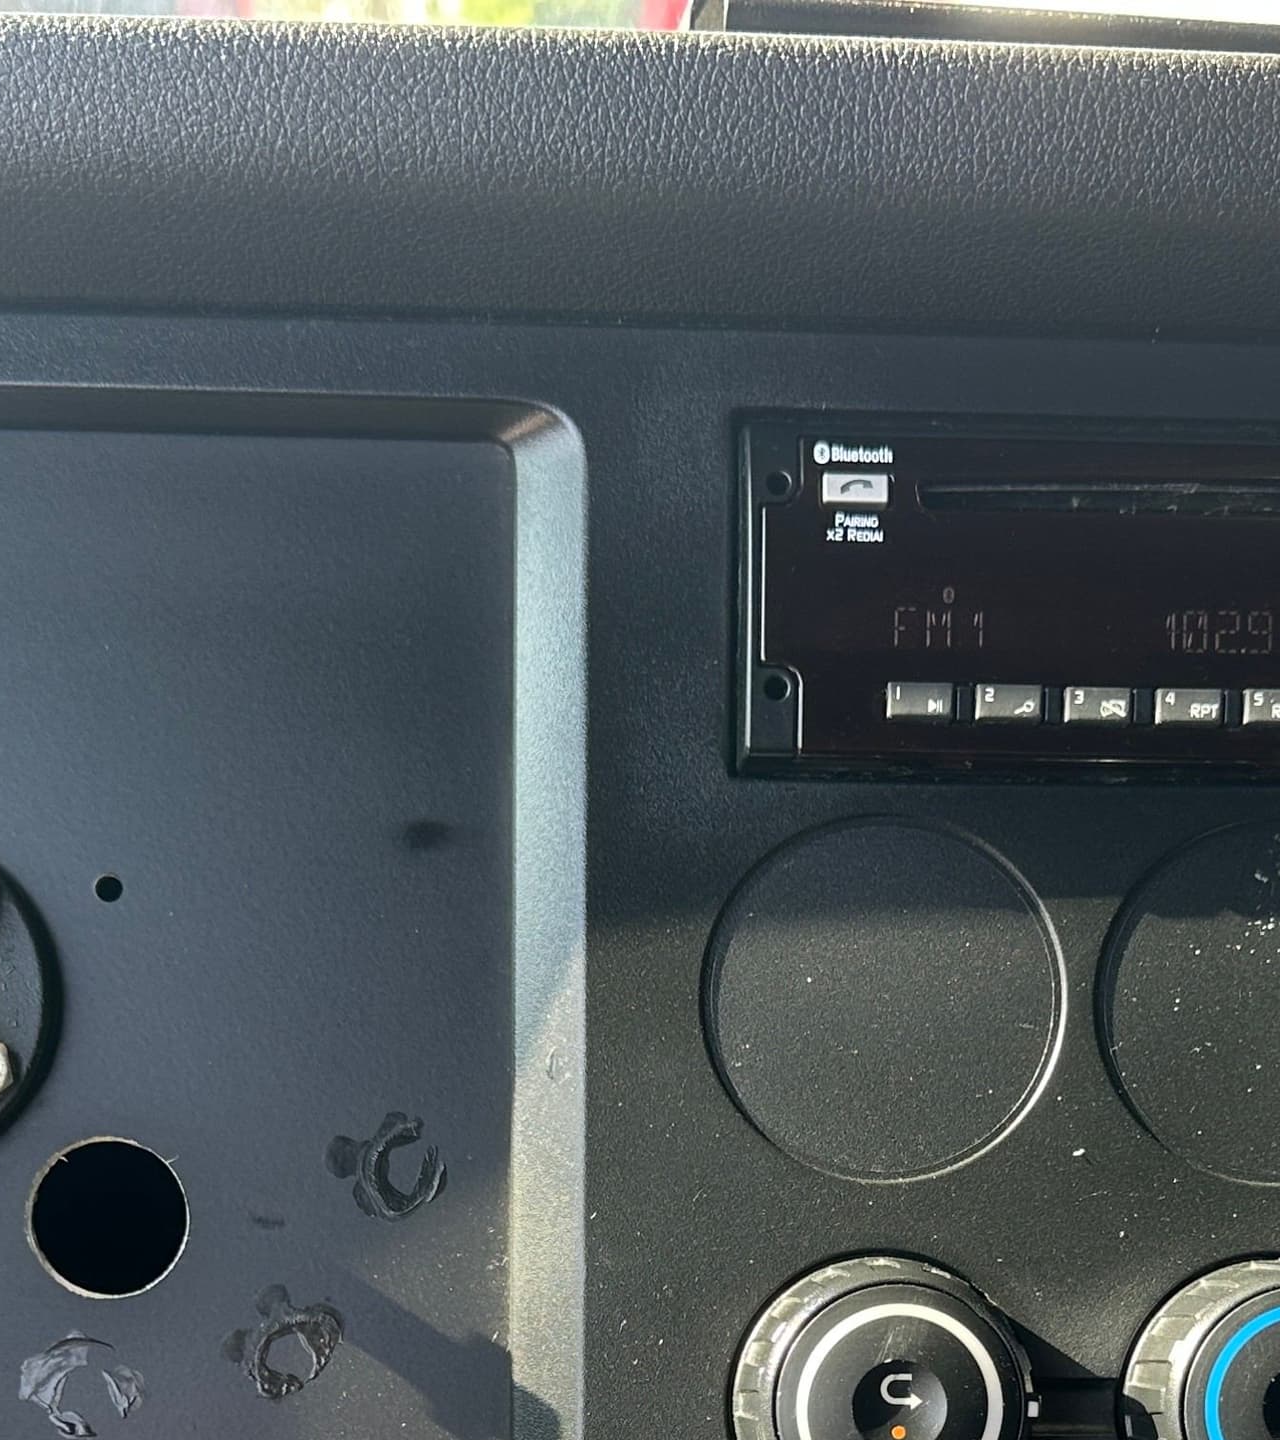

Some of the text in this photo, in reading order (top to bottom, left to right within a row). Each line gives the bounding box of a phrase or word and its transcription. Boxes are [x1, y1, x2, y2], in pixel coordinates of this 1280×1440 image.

[831, 444, 894, 464] Bluetooth
[984, 688, 995, 703] 2
[1074, 690, 1085, 706] 3
[1164, 691, 1176, 706] 4
[1253, 692, 1264, 707] 5
[1190, 703, 1219, 720] RPT
